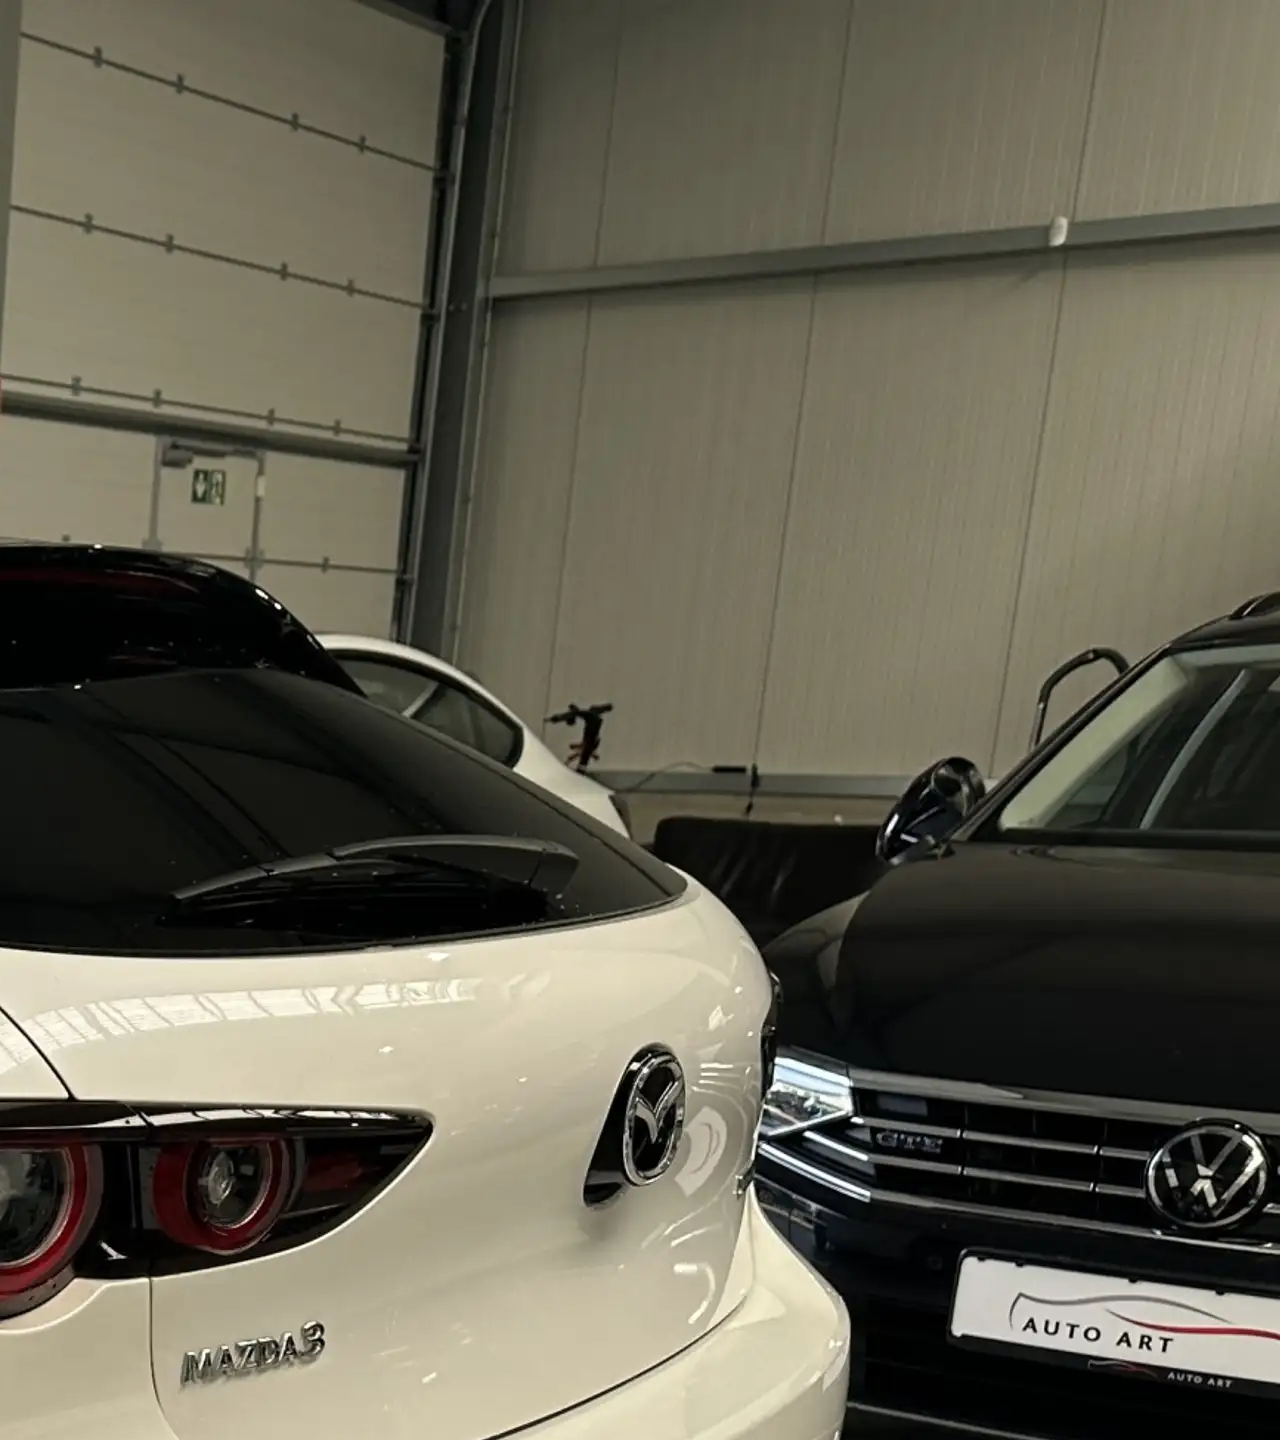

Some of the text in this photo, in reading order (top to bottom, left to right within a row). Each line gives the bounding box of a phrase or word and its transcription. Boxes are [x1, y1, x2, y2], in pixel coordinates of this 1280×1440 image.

[180, 1320, 326, 1384] MAZDA3
[1022, 1317, 1174, 1353] AUTO ART
[1167, 1371, 1233, 1389] AUTO ART
